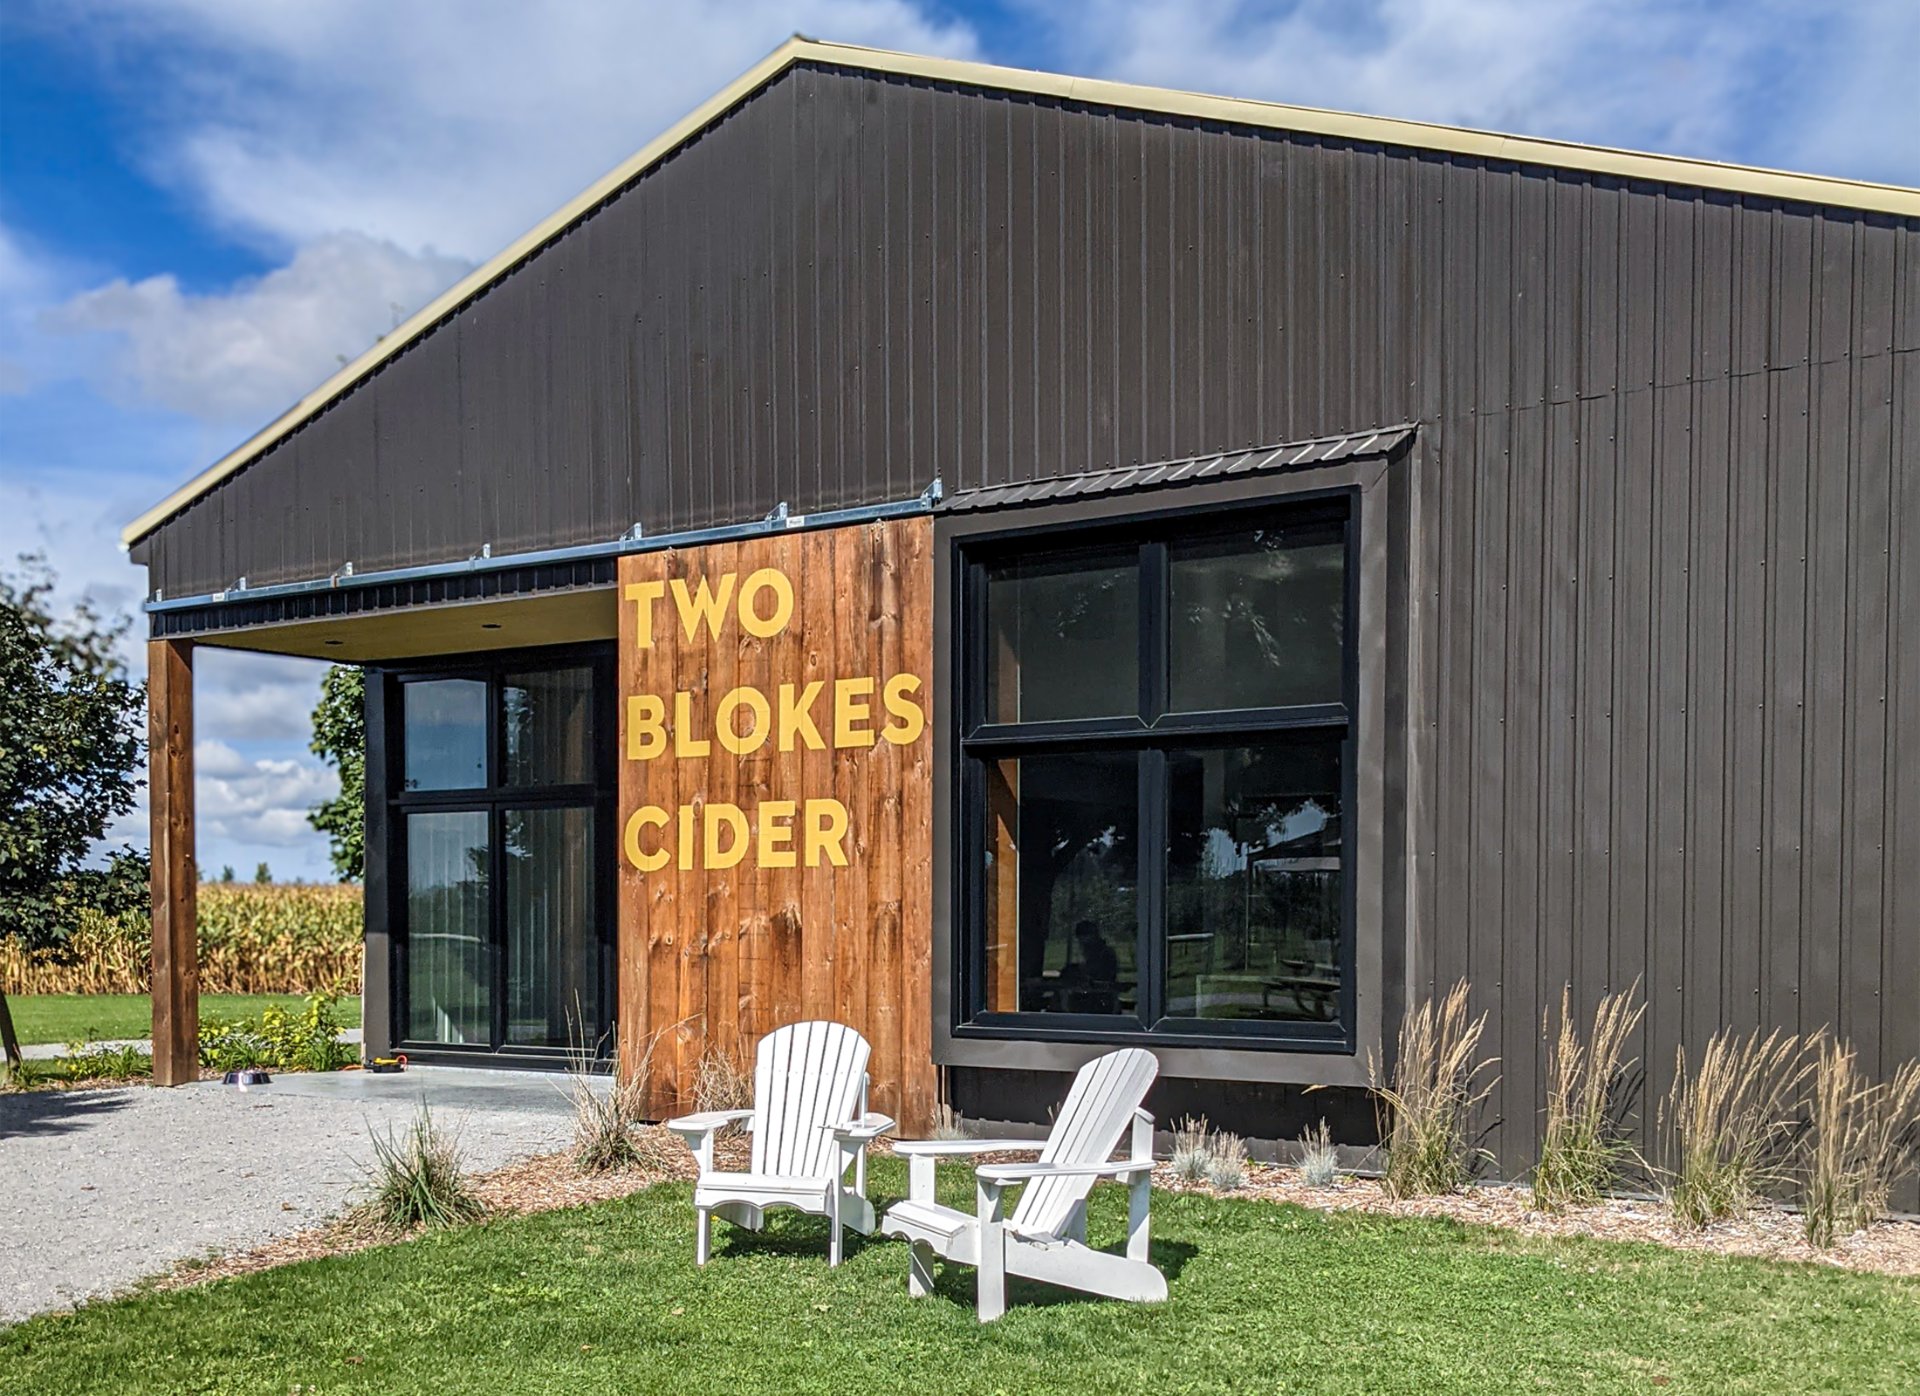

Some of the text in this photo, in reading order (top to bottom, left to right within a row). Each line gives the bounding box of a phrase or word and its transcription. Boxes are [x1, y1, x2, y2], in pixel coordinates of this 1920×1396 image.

[625, 568, 794, 648] TWO
[627, 673, 924, 760] BLOKES
[625, 798, 848, 872] CIDER
